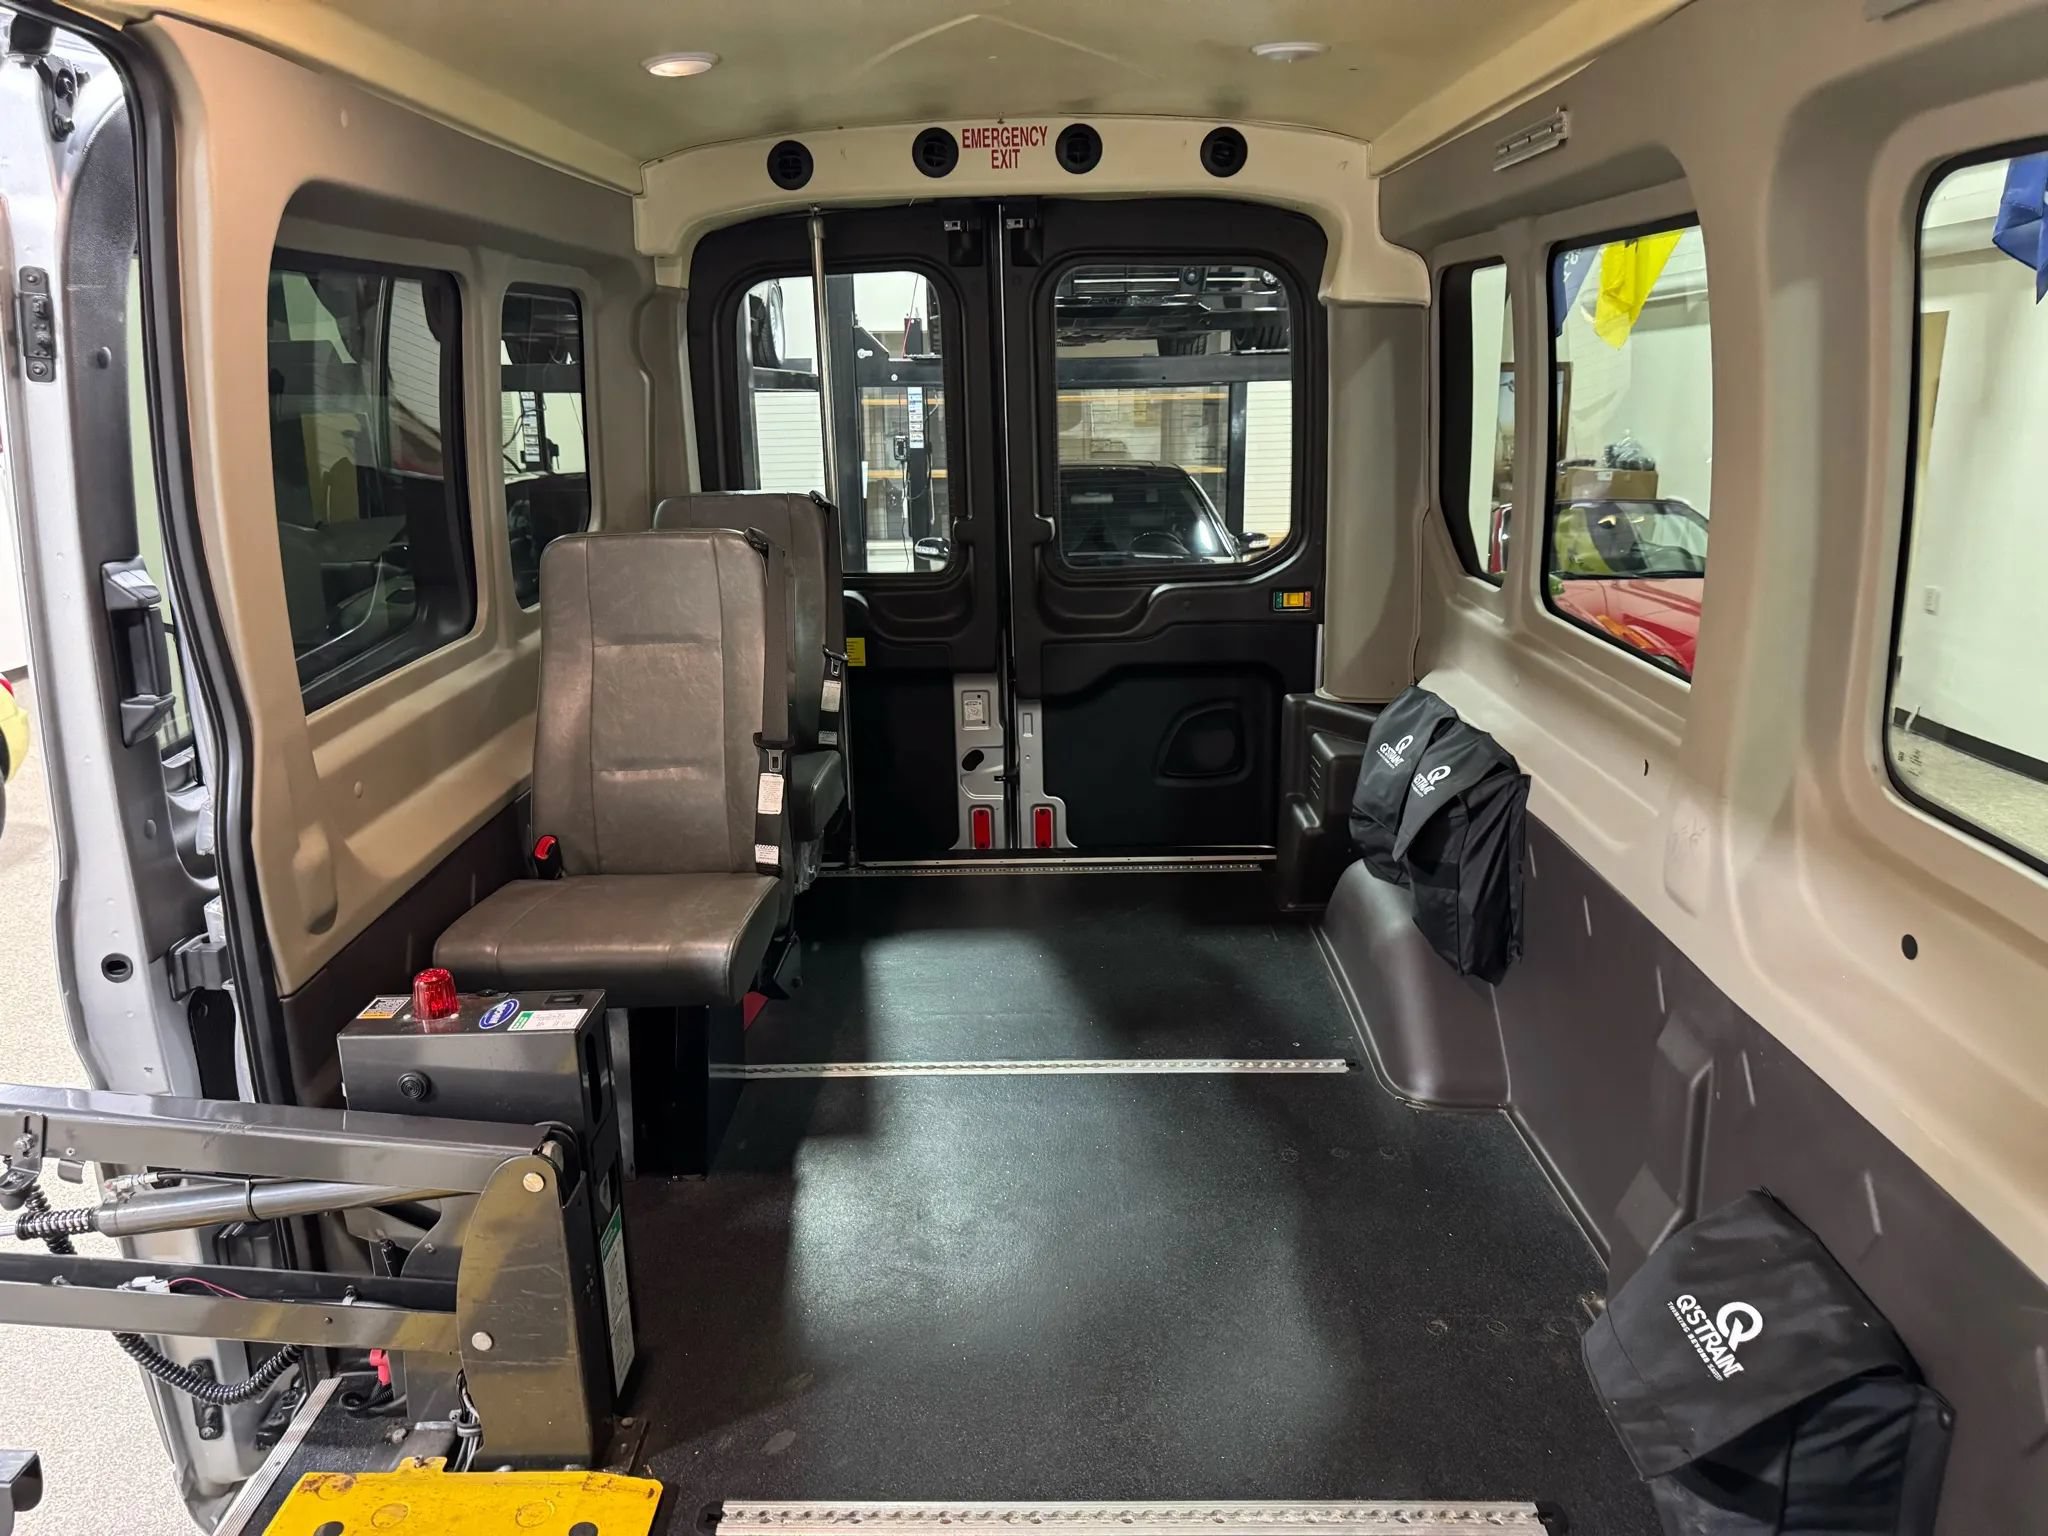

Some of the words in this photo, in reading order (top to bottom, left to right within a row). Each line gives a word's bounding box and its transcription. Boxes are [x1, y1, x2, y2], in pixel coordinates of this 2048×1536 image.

[962, 126, 1047, 148] EMERGENCY
[992, 149, 1020, 169] EXIT
[1395, 735, 1414, 755] Q
[1427, 765, 1451, 785] Q
[1716, 1302, 1763, 1352] Q
